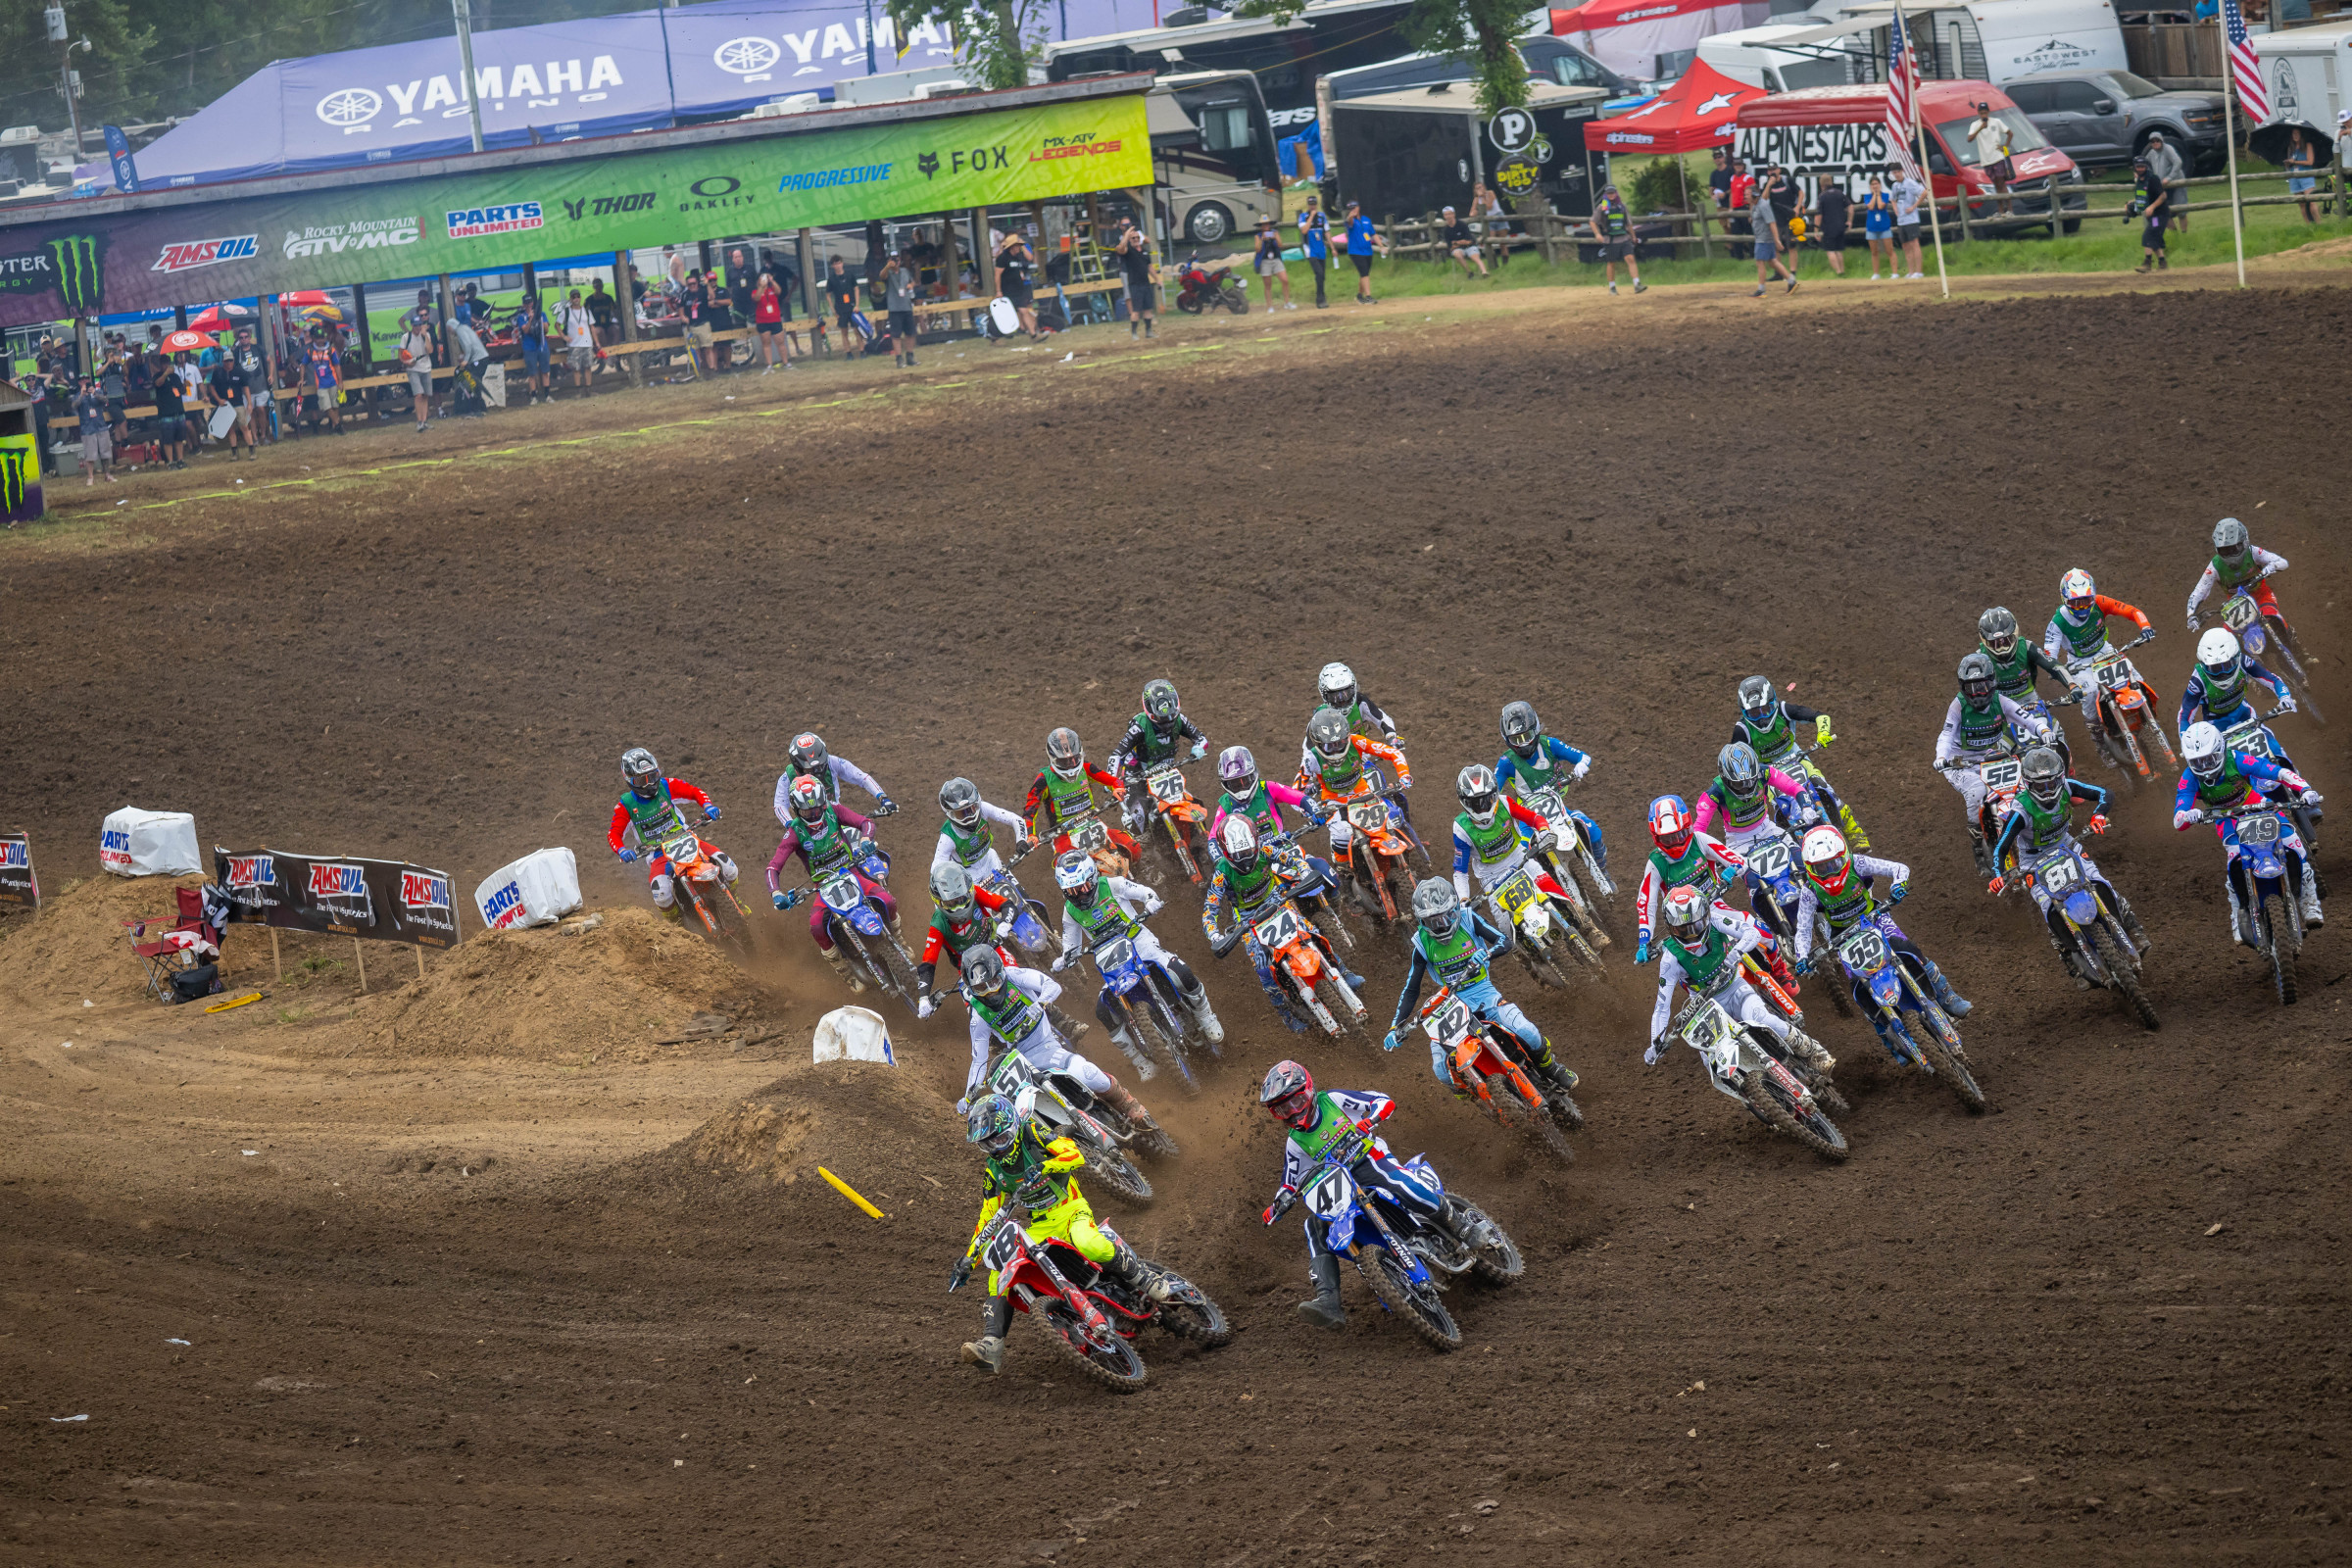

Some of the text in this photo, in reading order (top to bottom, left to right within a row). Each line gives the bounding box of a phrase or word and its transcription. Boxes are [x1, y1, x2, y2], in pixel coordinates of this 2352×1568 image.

[1616, 5, 1678, 22] alpinestars
[2014, 49, 2096, 64] EAST WEST
[386, 54, 624, 116] YAMAHA
[344, 92, 608, 135] RACING
[1044, 132, 1097, 148] MX-ATV
[1500, 113, 1526, 146] P
[1606, 131, 1654, 145] alpinestars
[1741, 123, 1887, 165] ALPINESTARS
[952, 146, 1009, 174] FOX
[1029, 140, 1122, 163] LEGENDS
[778, 163, 893, 193] PROGRESSIVE
[1496, 167, 1539, 182] DIRTY
[448, 202, 540, 227] PARTS
[591, 192, 657, 217] THOR
[679, 195, 756, 213] OAKLEY
[304, 216, 417, 240] ROCKY MOUNTAIN
[450, 218, 543, 238] UNLIMITED
[158, 236, 258, 270] AMSOIL
[2097, 660, 2131, 686] 94
[1155, 774, 1184, 801] 26
[1986, 762, 2018, 784] 52
[1355, 805, 1386, 829] 29
[2238, 817, 2278, 846] 49
[672, 837, 698, 863] 23
[1078, 824, 1107, 850] 43
[229, 858, 274, 888] AMSOIL
[1752, 845, 1789, 877] 72
[2044, 857, 2080, 894] 81
[311, 865, 366, 895] AMSOIL
[403, 873, 450, 906] AMSOIL
[1504, 879, 1534, 911] 68
[1261, 911, 1298, 947] 24
[1847, 936, 1882, 970] 55
[1437, 1004, 1470, 1046] 42
[1692, 1010, 1724, 1049] 37
[996, 1056, 1029, 1099] 57
[1287, 1150, 1301, 1187] FLY
[1315, 1168, 1344, 1214] 47
[987, 1222, 1018, 1270] 18
[1389, 1235, 1416, 1269] DUNLOP
